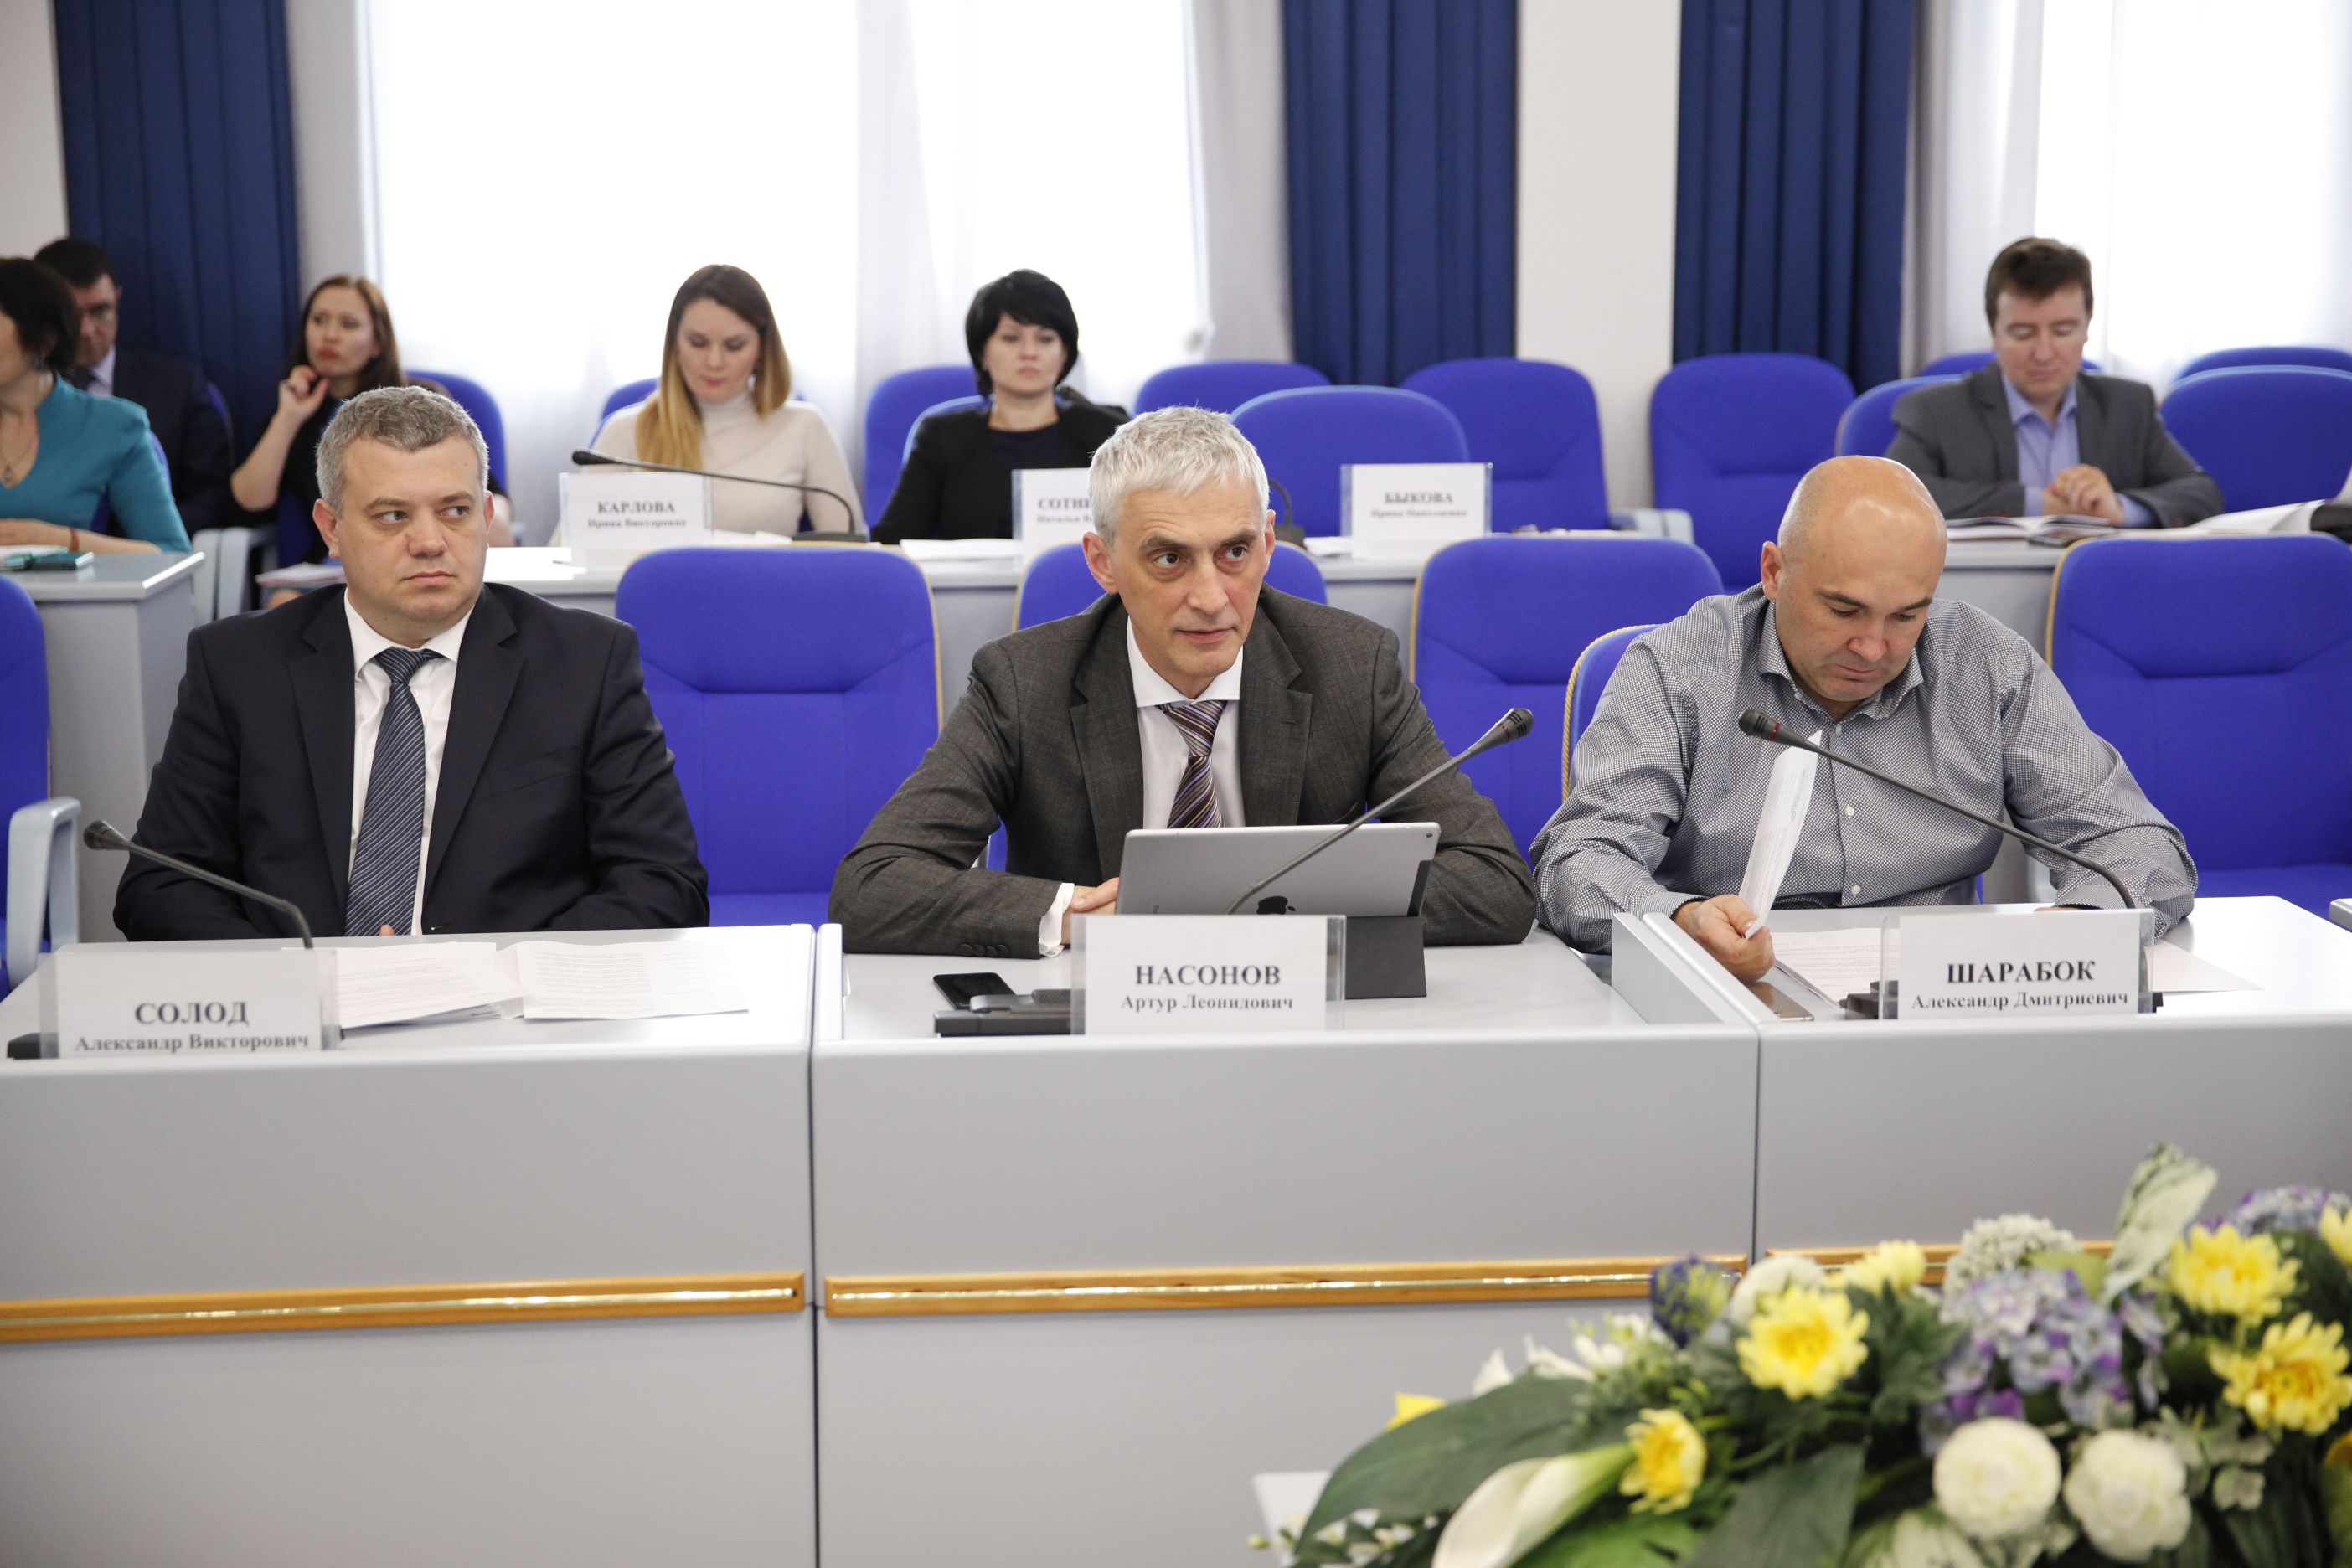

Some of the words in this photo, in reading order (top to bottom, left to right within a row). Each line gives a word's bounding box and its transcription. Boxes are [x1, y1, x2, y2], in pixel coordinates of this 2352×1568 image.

[597, 501, 675, 513] КАРЛОВА
[1385, 491, 1453, 503] БЫКОВА
[1135, 964, 1282, 985] НАСОНОВ
[1947, 960, 2097, 983] ШАРАБОК
[1121, 994, 1177, 1013] Артур
[1183, 994, 1293, 1011] Леонидович
[1911, 993, 2009, 1011] Александр
[2014, 990, 2129, 1010] Дмитриевич
[135, 1001, 250, 1026] СОЛОД
[75, 1034, 183, 1054] Александр
[188, 1033, 309, 1052] Викторович
